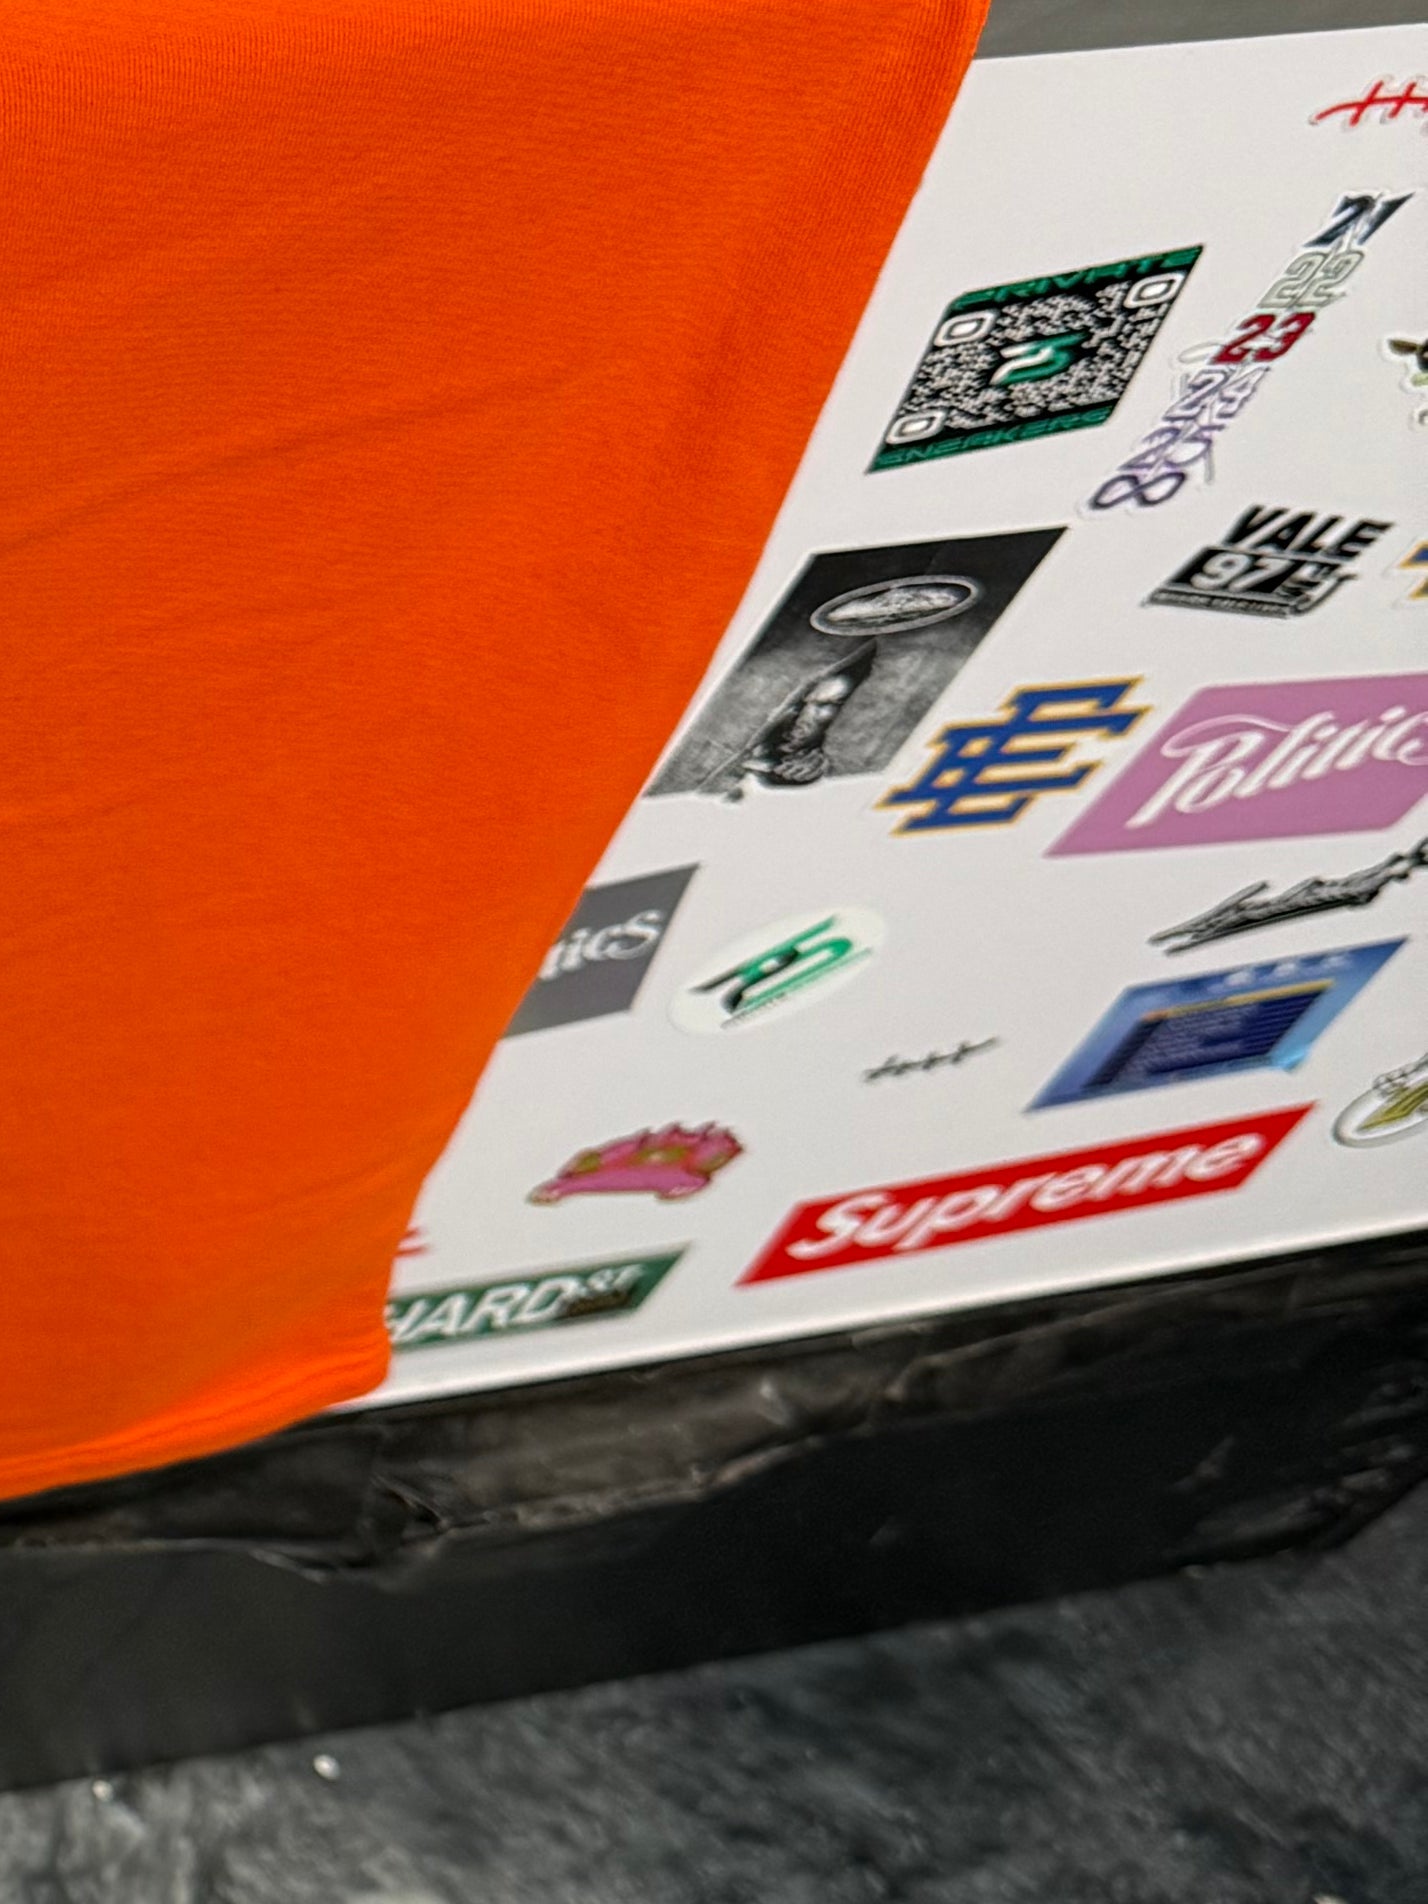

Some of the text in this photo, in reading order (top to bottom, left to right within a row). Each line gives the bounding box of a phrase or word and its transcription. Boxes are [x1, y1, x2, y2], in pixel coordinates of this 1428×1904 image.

[1207, 310, 1317, 366] 23
[1217, 504, 1394, 560] VALE
[1190, 551, 1295, 593] 97
[785, 1133, 1268, 1260] Supreme
